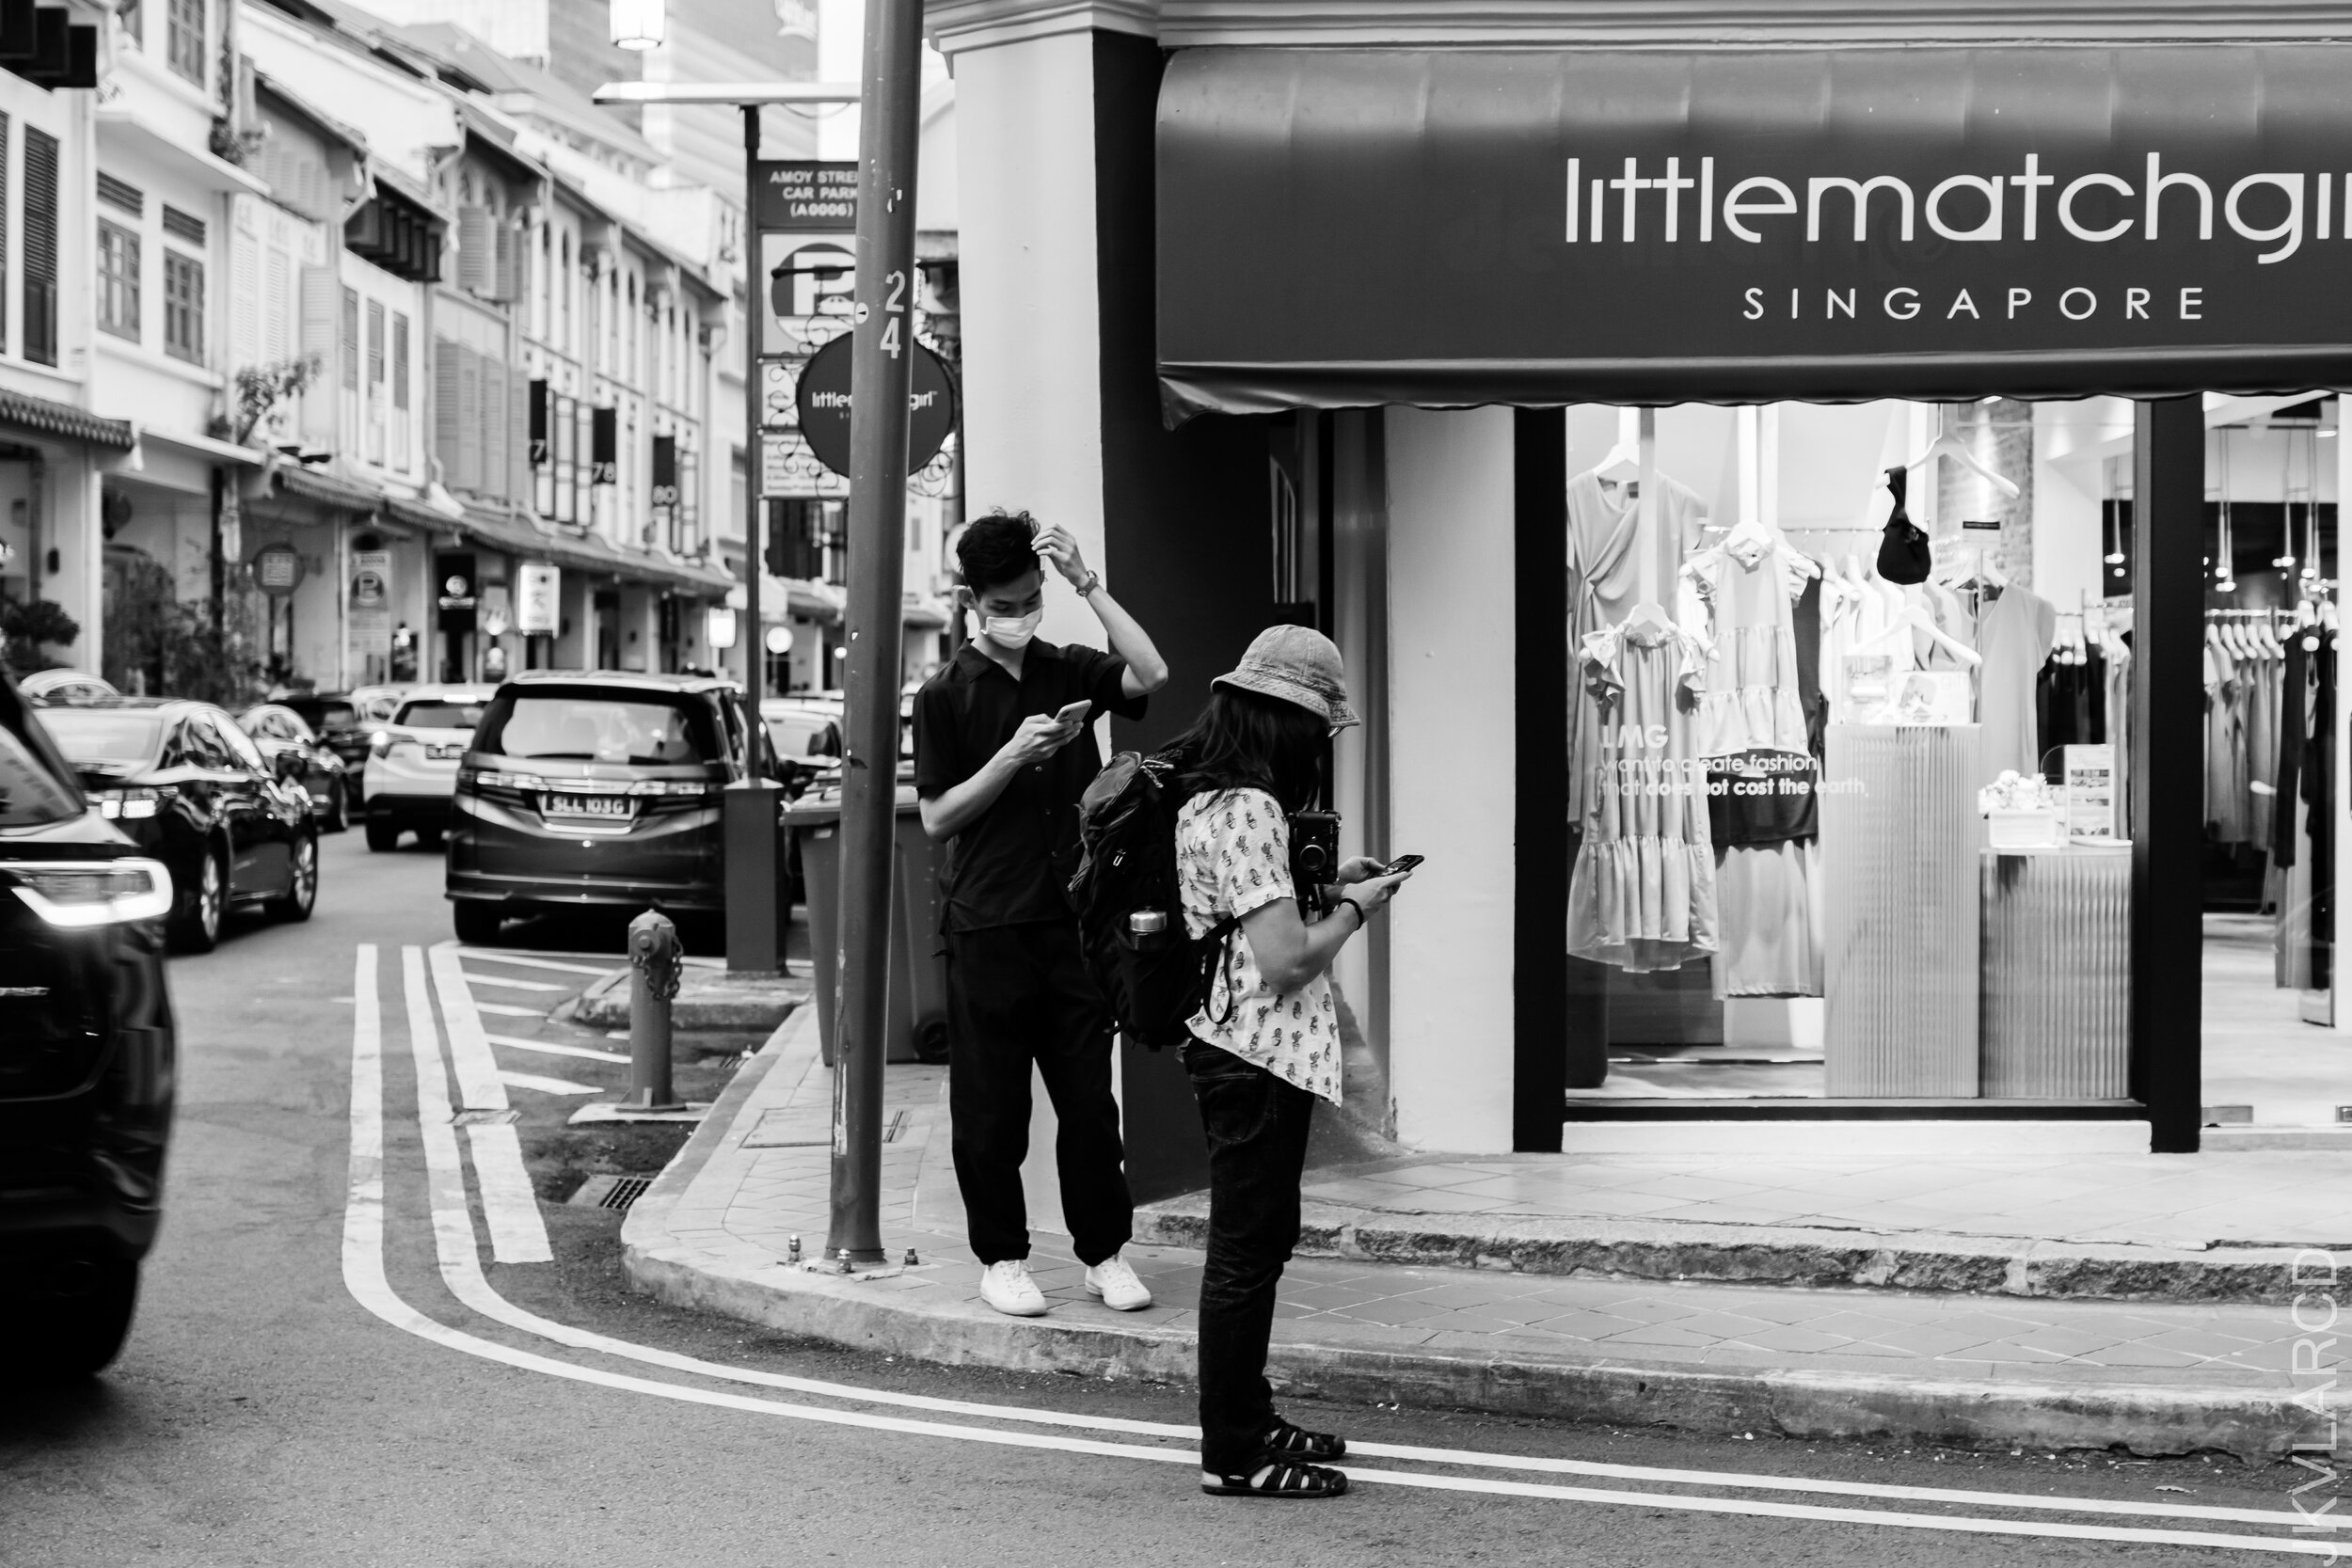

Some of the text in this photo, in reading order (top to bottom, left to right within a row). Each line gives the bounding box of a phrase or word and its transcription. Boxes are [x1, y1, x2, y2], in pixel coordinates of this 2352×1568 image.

[769, 170, 858, 183] AMOY STRE
[782, 186, 814, 199] CAR
[1742, 287, 2203, 321] SINGAPORE
[1601, 723, 1669, 749] LMG
[1601, 753, 1818, 772] want to create fashion
[1601, 778, 1641, 797] that
[1645, 778, 1693, 797] does
[1699, 778, 1728, 796] not
[1733, 778, 1774, 796] cost
[1778, 778, 1810, 795] the
